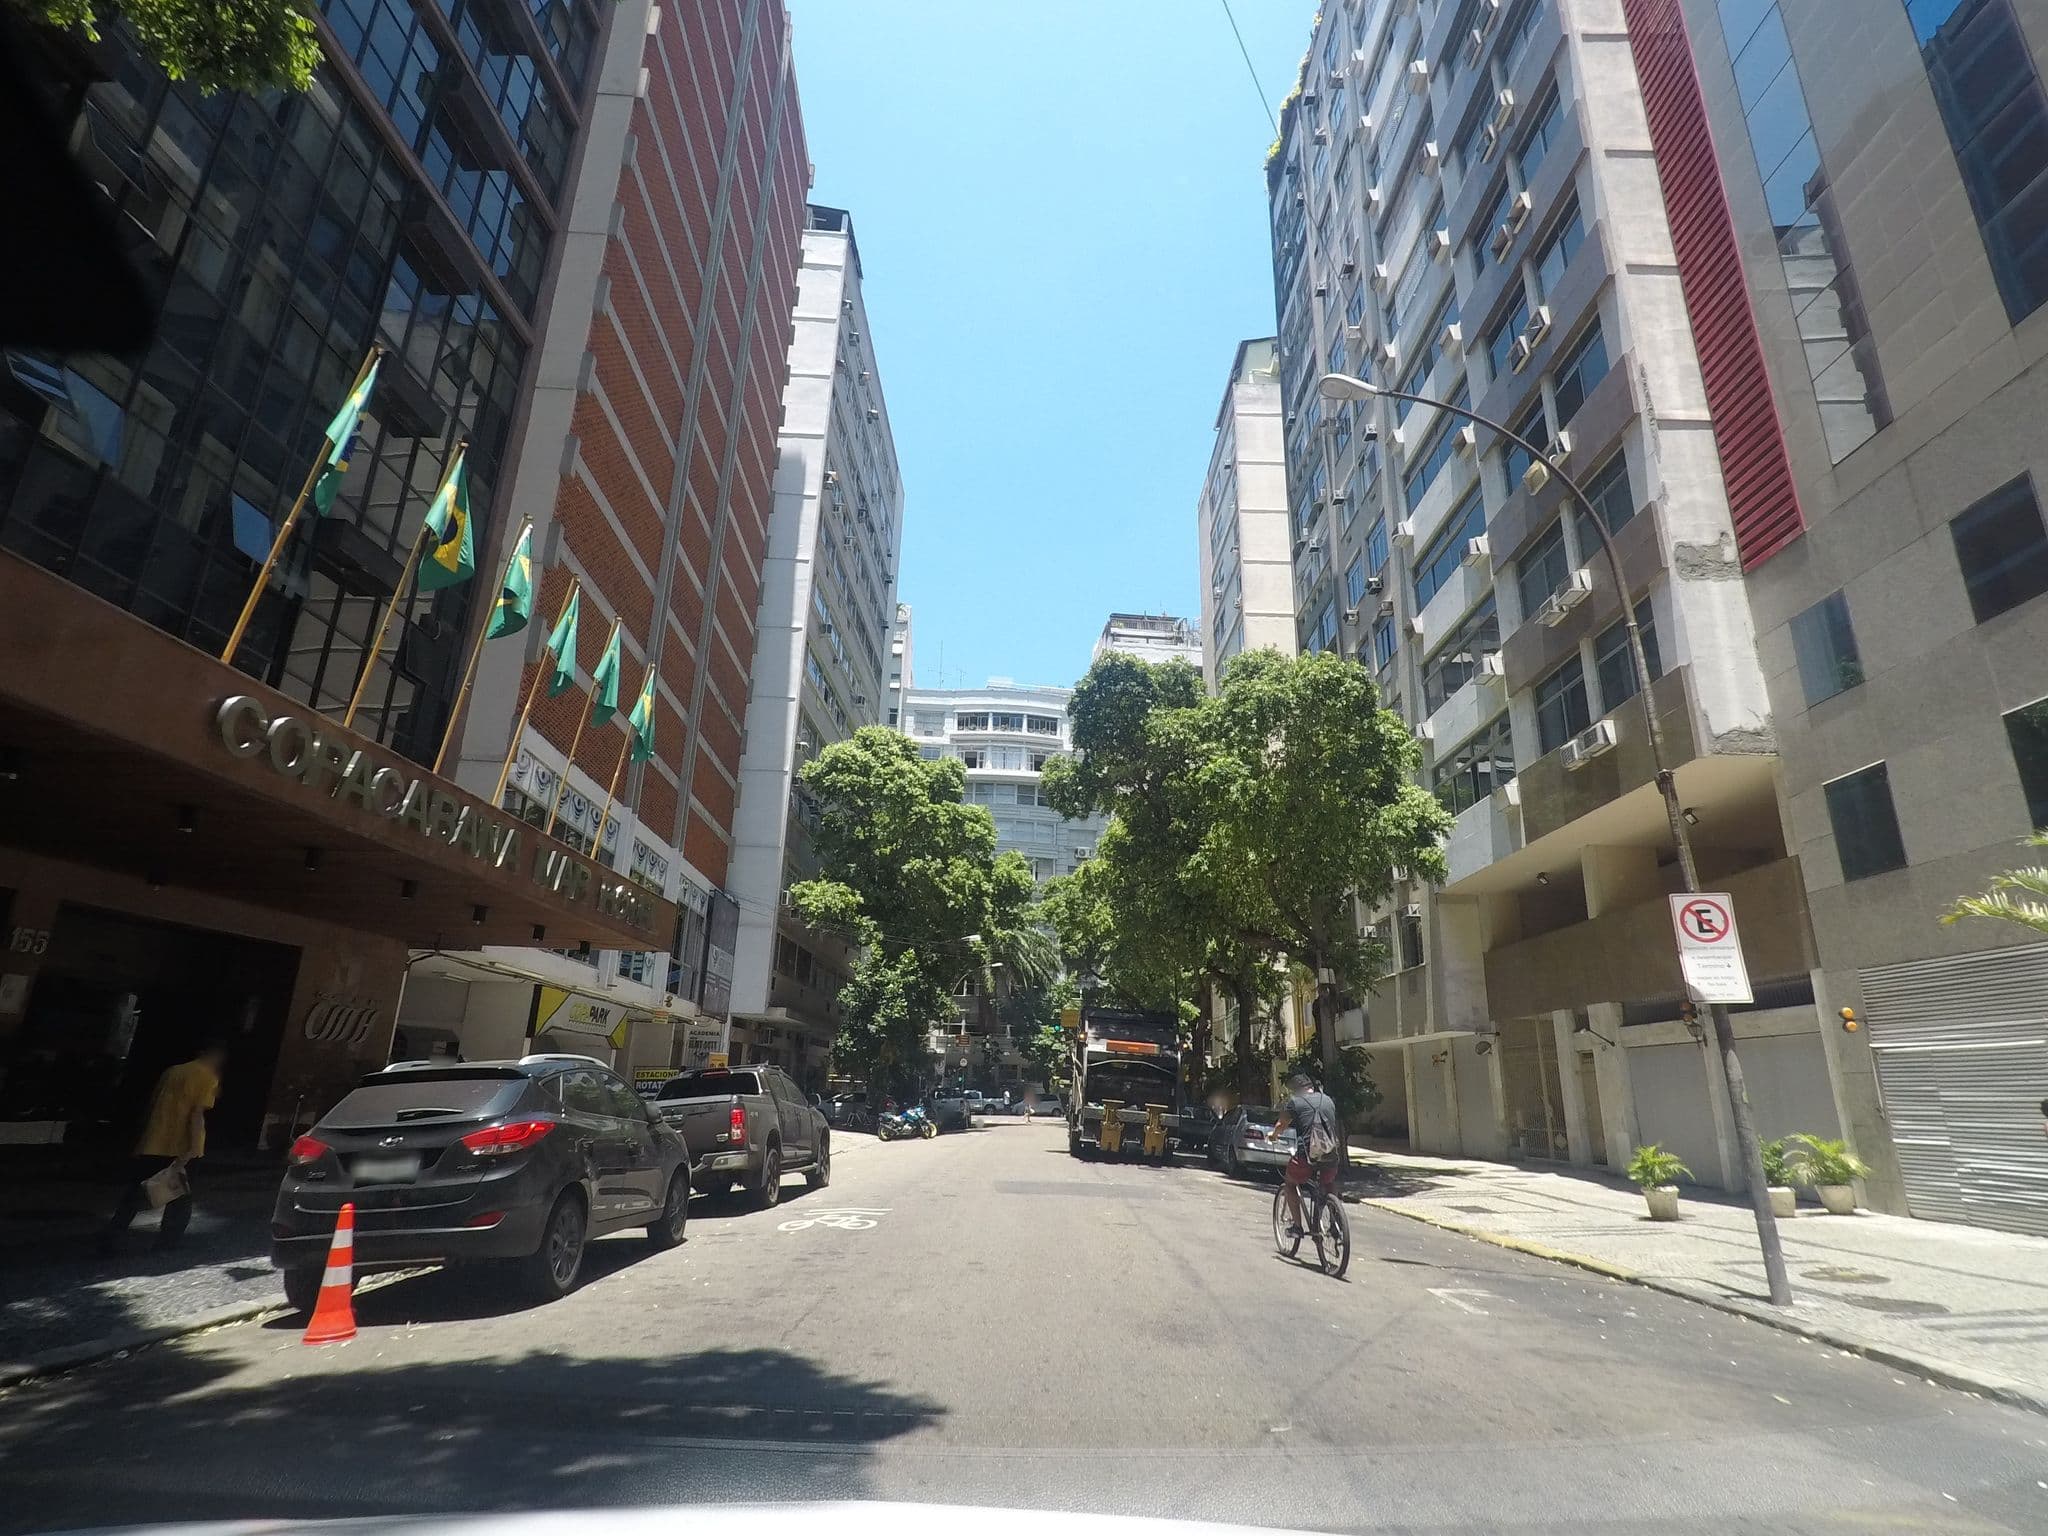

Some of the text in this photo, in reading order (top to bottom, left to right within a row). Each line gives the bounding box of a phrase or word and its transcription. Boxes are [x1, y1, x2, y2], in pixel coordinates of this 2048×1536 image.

[217, 695, 520, 872] COPACABANA
[1695, 909, 1714, 933] E
[10, 927, 49, 954] 155
